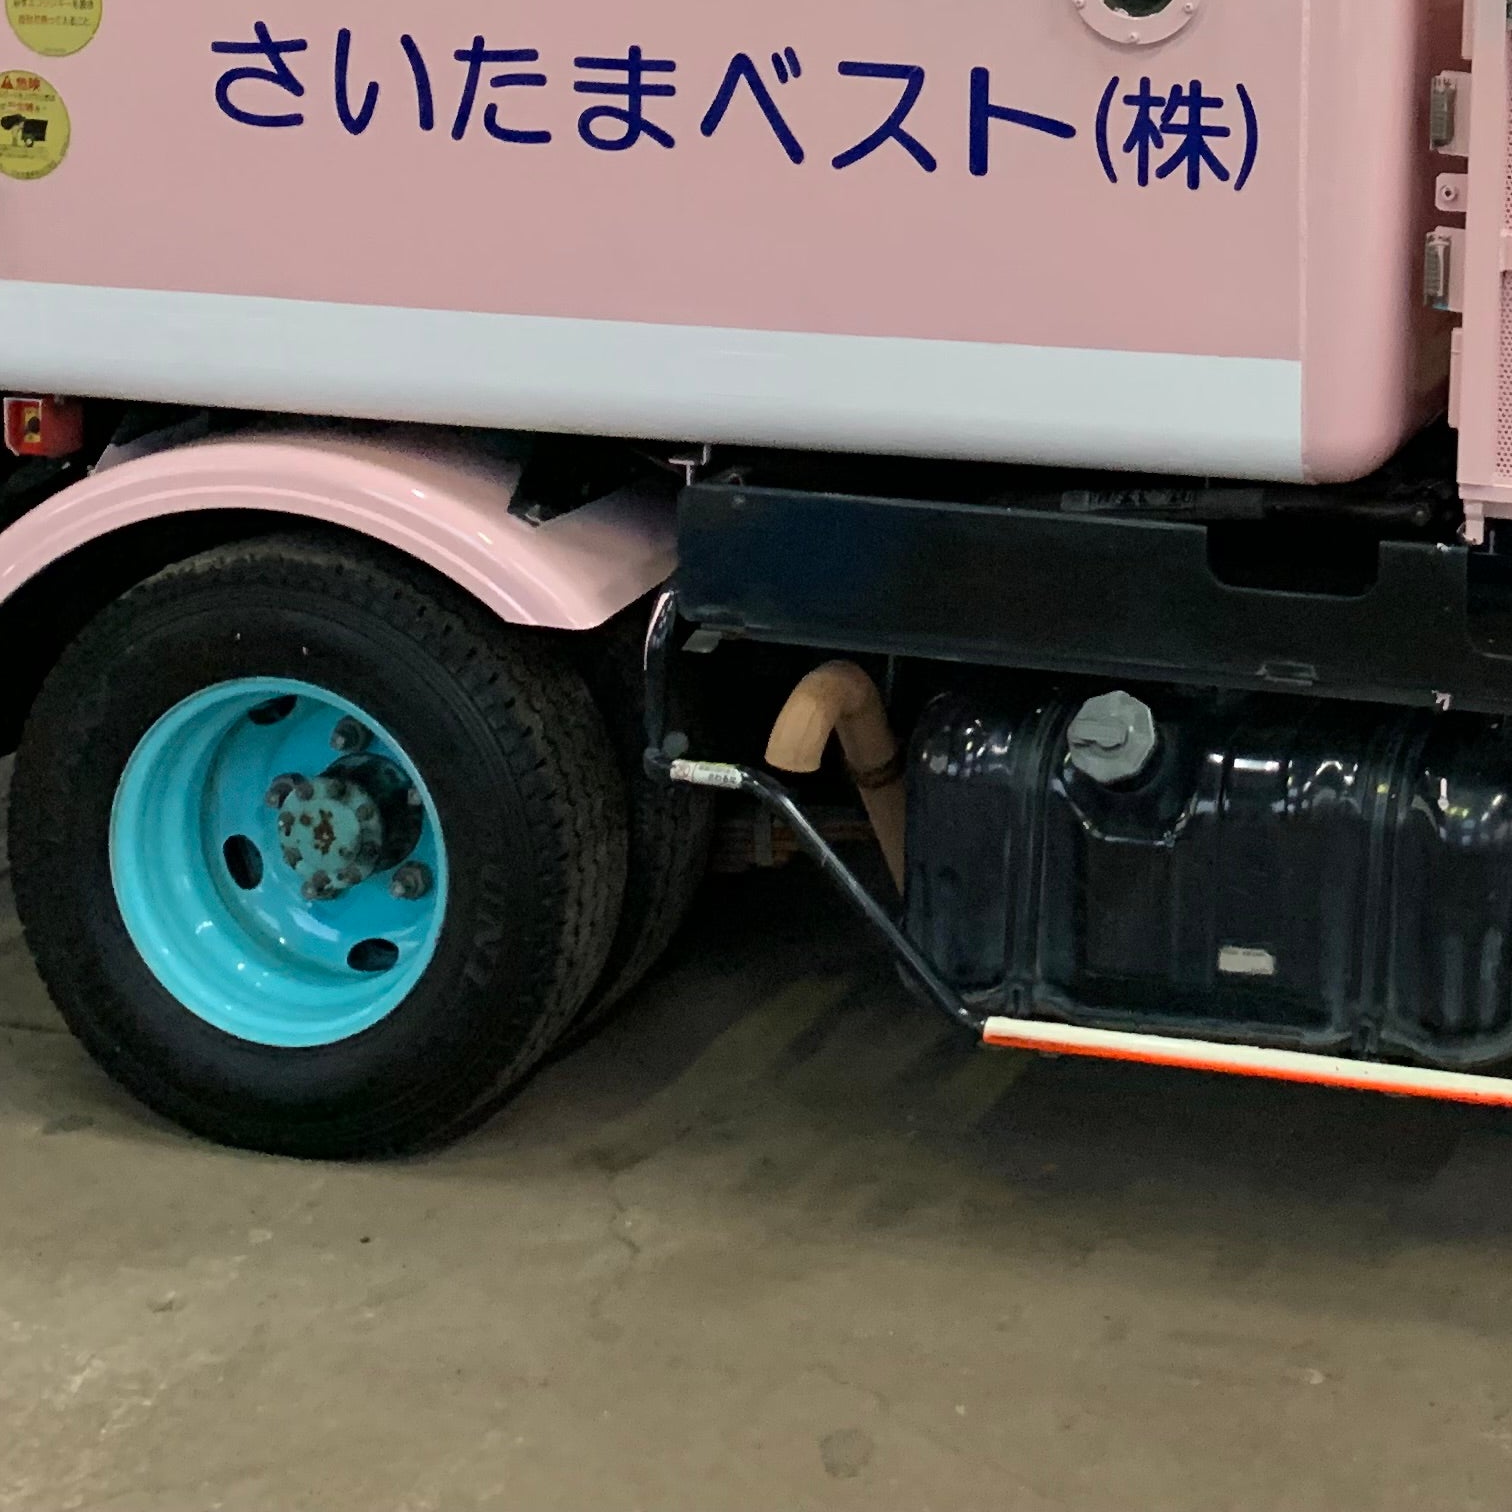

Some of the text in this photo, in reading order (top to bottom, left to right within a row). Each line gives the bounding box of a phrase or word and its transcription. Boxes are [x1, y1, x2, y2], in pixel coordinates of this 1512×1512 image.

[211, 21, 1259, 191] さいたまベスト(株)
